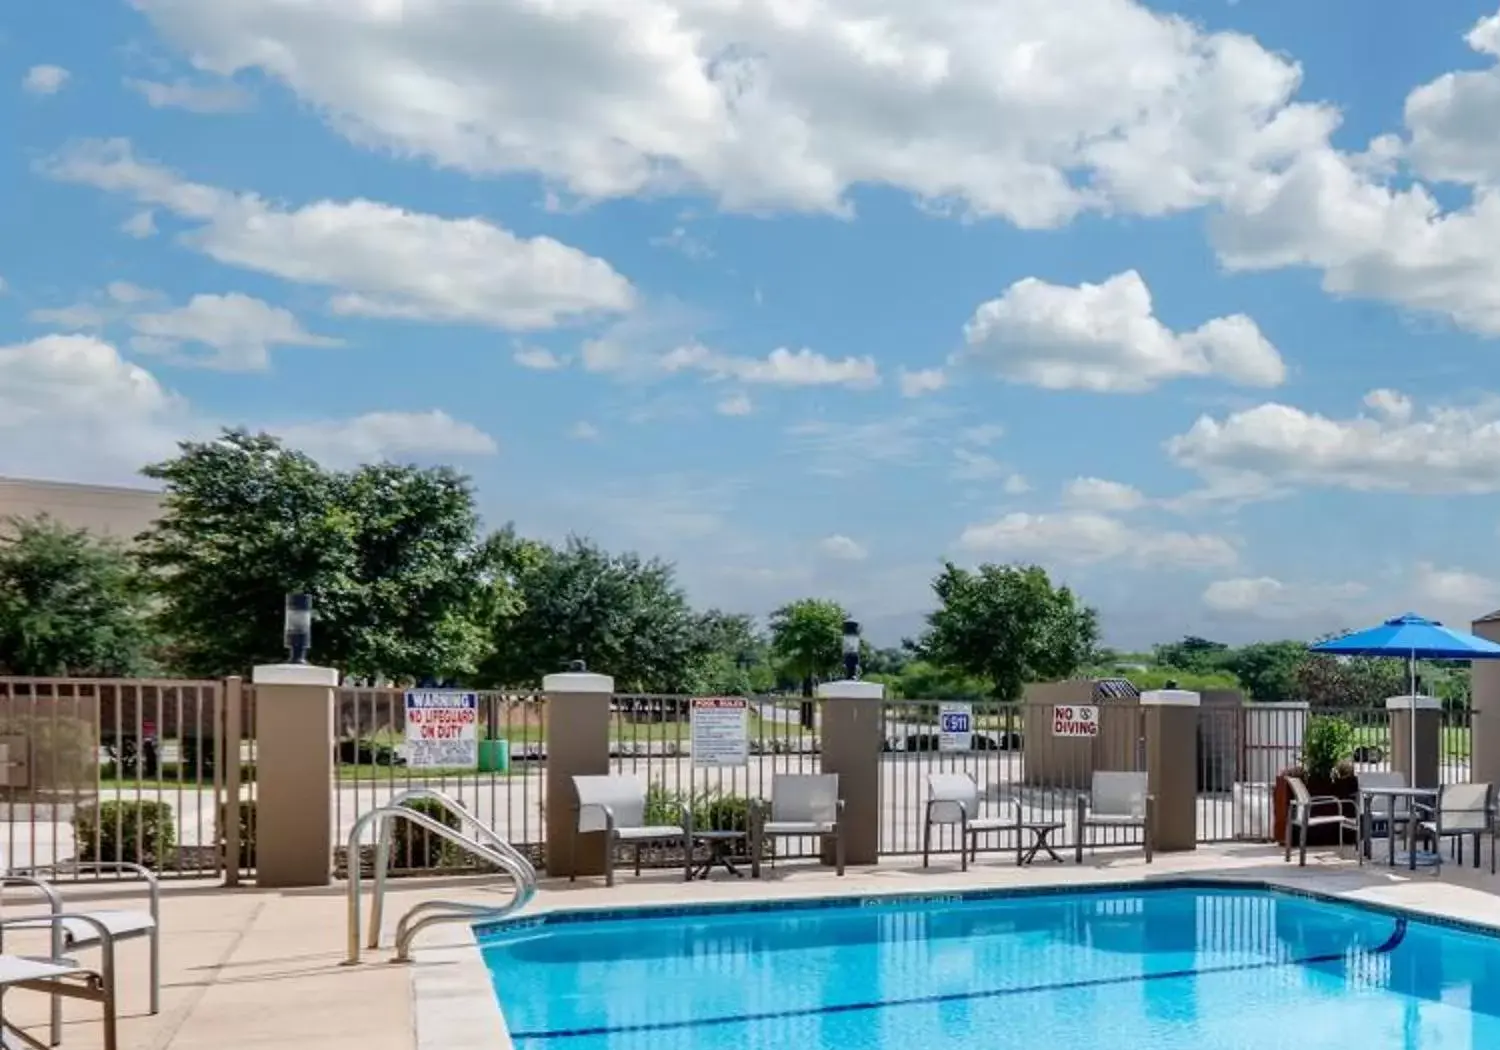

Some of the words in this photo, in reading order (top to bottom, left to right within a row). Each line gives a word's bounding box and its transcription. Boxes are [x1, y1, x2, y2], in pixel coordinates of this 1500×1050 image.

[412, 693, 469, 707] WARNING
[409, 709, 421, 723] NO
[426, 709, 474, 723] LIFEGUARD
[1055, 707, 1073, 720] NO
[421, 725, 434, 738] ON
[438, 725, 462, 738] DUTY
[1055, 721, 1097, 734] DIVING
